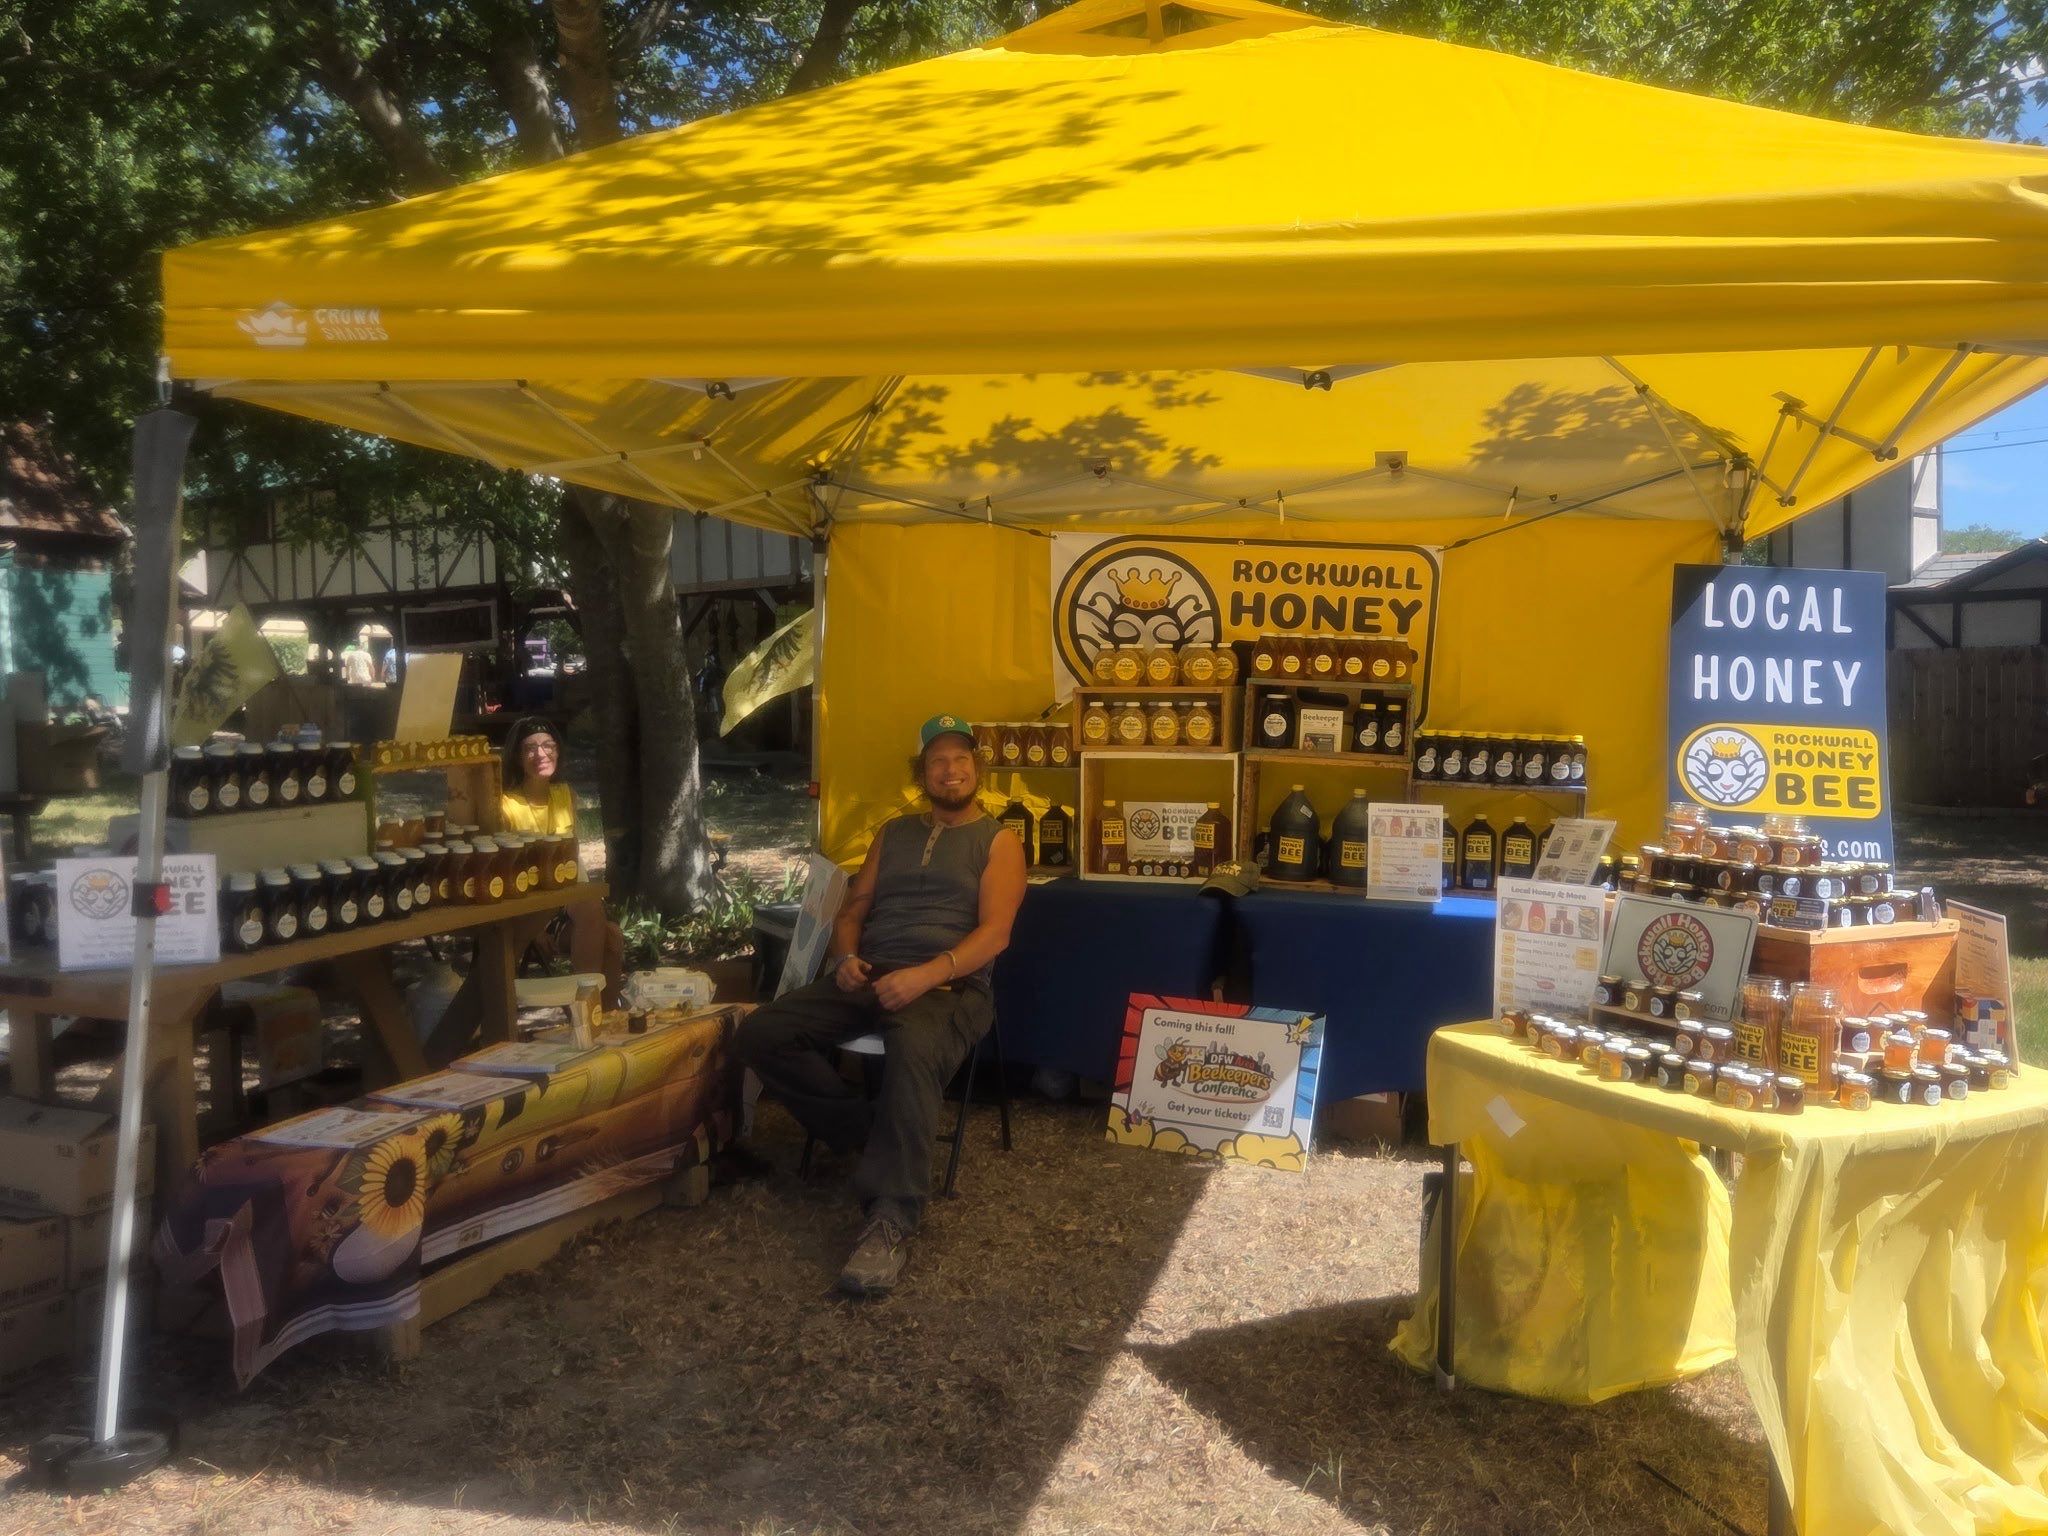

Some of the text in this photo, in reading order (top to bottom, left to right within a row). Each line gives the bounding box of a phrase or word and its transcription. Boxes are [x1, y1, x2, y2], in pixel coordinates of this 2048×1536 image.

[315, 308, 380, 324] CROWN
[322, 327, 389, 341] SHADES
[1232, 559, 1423, 590] ROCKWALL
[1229, 591, 1423, 634] HONEY
[1704, 582, 1852, 633] LOCAL
[1694, 654, 1861, 706] HONEY
[1303, 714, 1339, 722] Beekeeper
[1774, 733, 1873, 749] ROCKWALL
[1774, 749, 1873, 770] HONEY
[1775, 773, 1877, 809] BEE
[1104, 830, 1123, 838] BEE
[1281, 848, 1302, 856] BEE
[1344, 852, 1365, 860] BEE
[1467, 845, 1489, 853] BEE
[1507, 848, 1529, 857] BEE
[162, 875, 205, 888] NEY
[1511, 886, 1531, 895] Local
[1532, 888, 1556, 899] Honey
[1557, 891, 1565, 899] &
[1639, 915, 1672, 984] Rockwall
[1678, 914, 1710, 962] Honey
[1153, 1017, 1236, 1035] Coming this fall!
[1210, 1054, 1235, 1064] DFW
[1782, 1050, 1817, 1070] BEE
[1188, 1062, 1271, 1091] Beekeepers
[1193, 1082, 1258, 1099] Conference
[1167, 1101, 1251, 1122] Get your tickets:
